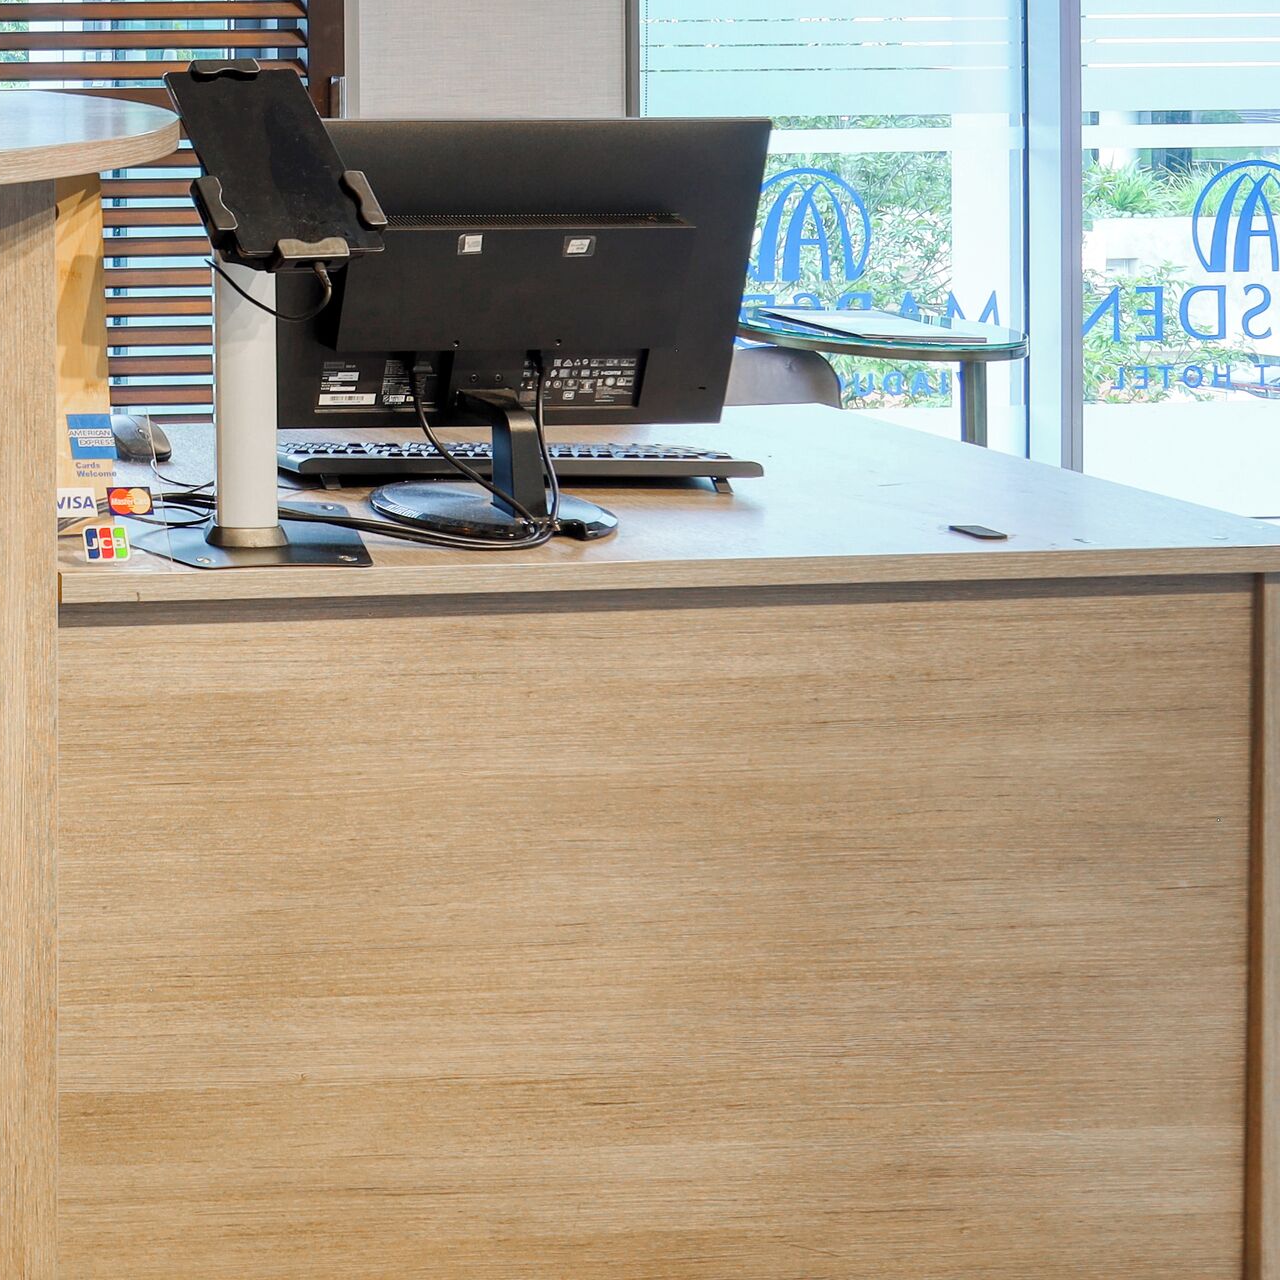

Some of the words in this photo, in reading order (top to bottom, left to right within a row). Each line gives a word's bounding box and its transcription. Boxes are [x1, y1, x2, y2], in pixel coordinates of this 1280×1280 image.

[69, 429, 111, 437] AMERICAN
[79, 438, 116, 447] EXPRESS
[75, 461, 101, 470] Cards
[77, 470, 117, 478] Welcome
[56, 495, 95, 510] VISA
[87, 537, 127, 550] JCB
